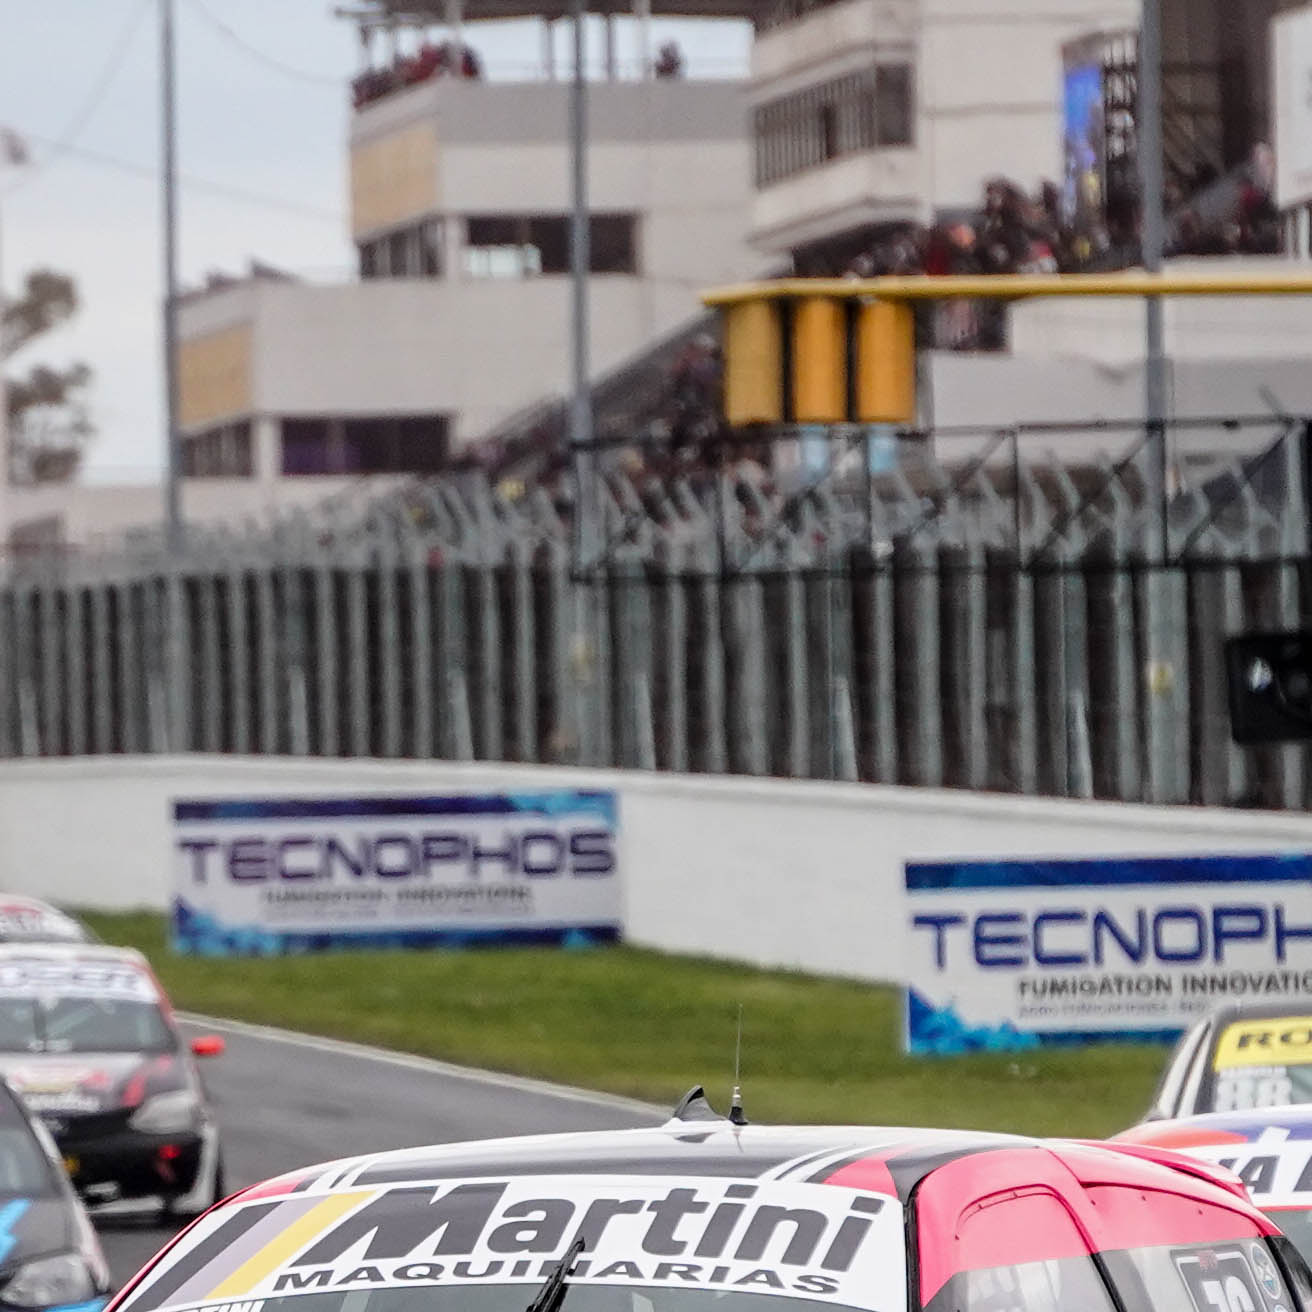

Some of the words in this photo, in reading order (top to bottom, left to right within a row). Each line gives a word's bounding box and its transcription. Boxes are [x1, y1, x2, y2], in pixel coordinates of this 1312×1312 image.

[176, 830, 618, 884] TECNOPHOS
[1018, 977, 1173, 998] FUMIGATION
[288, 1182, 886, 1273] Martini
